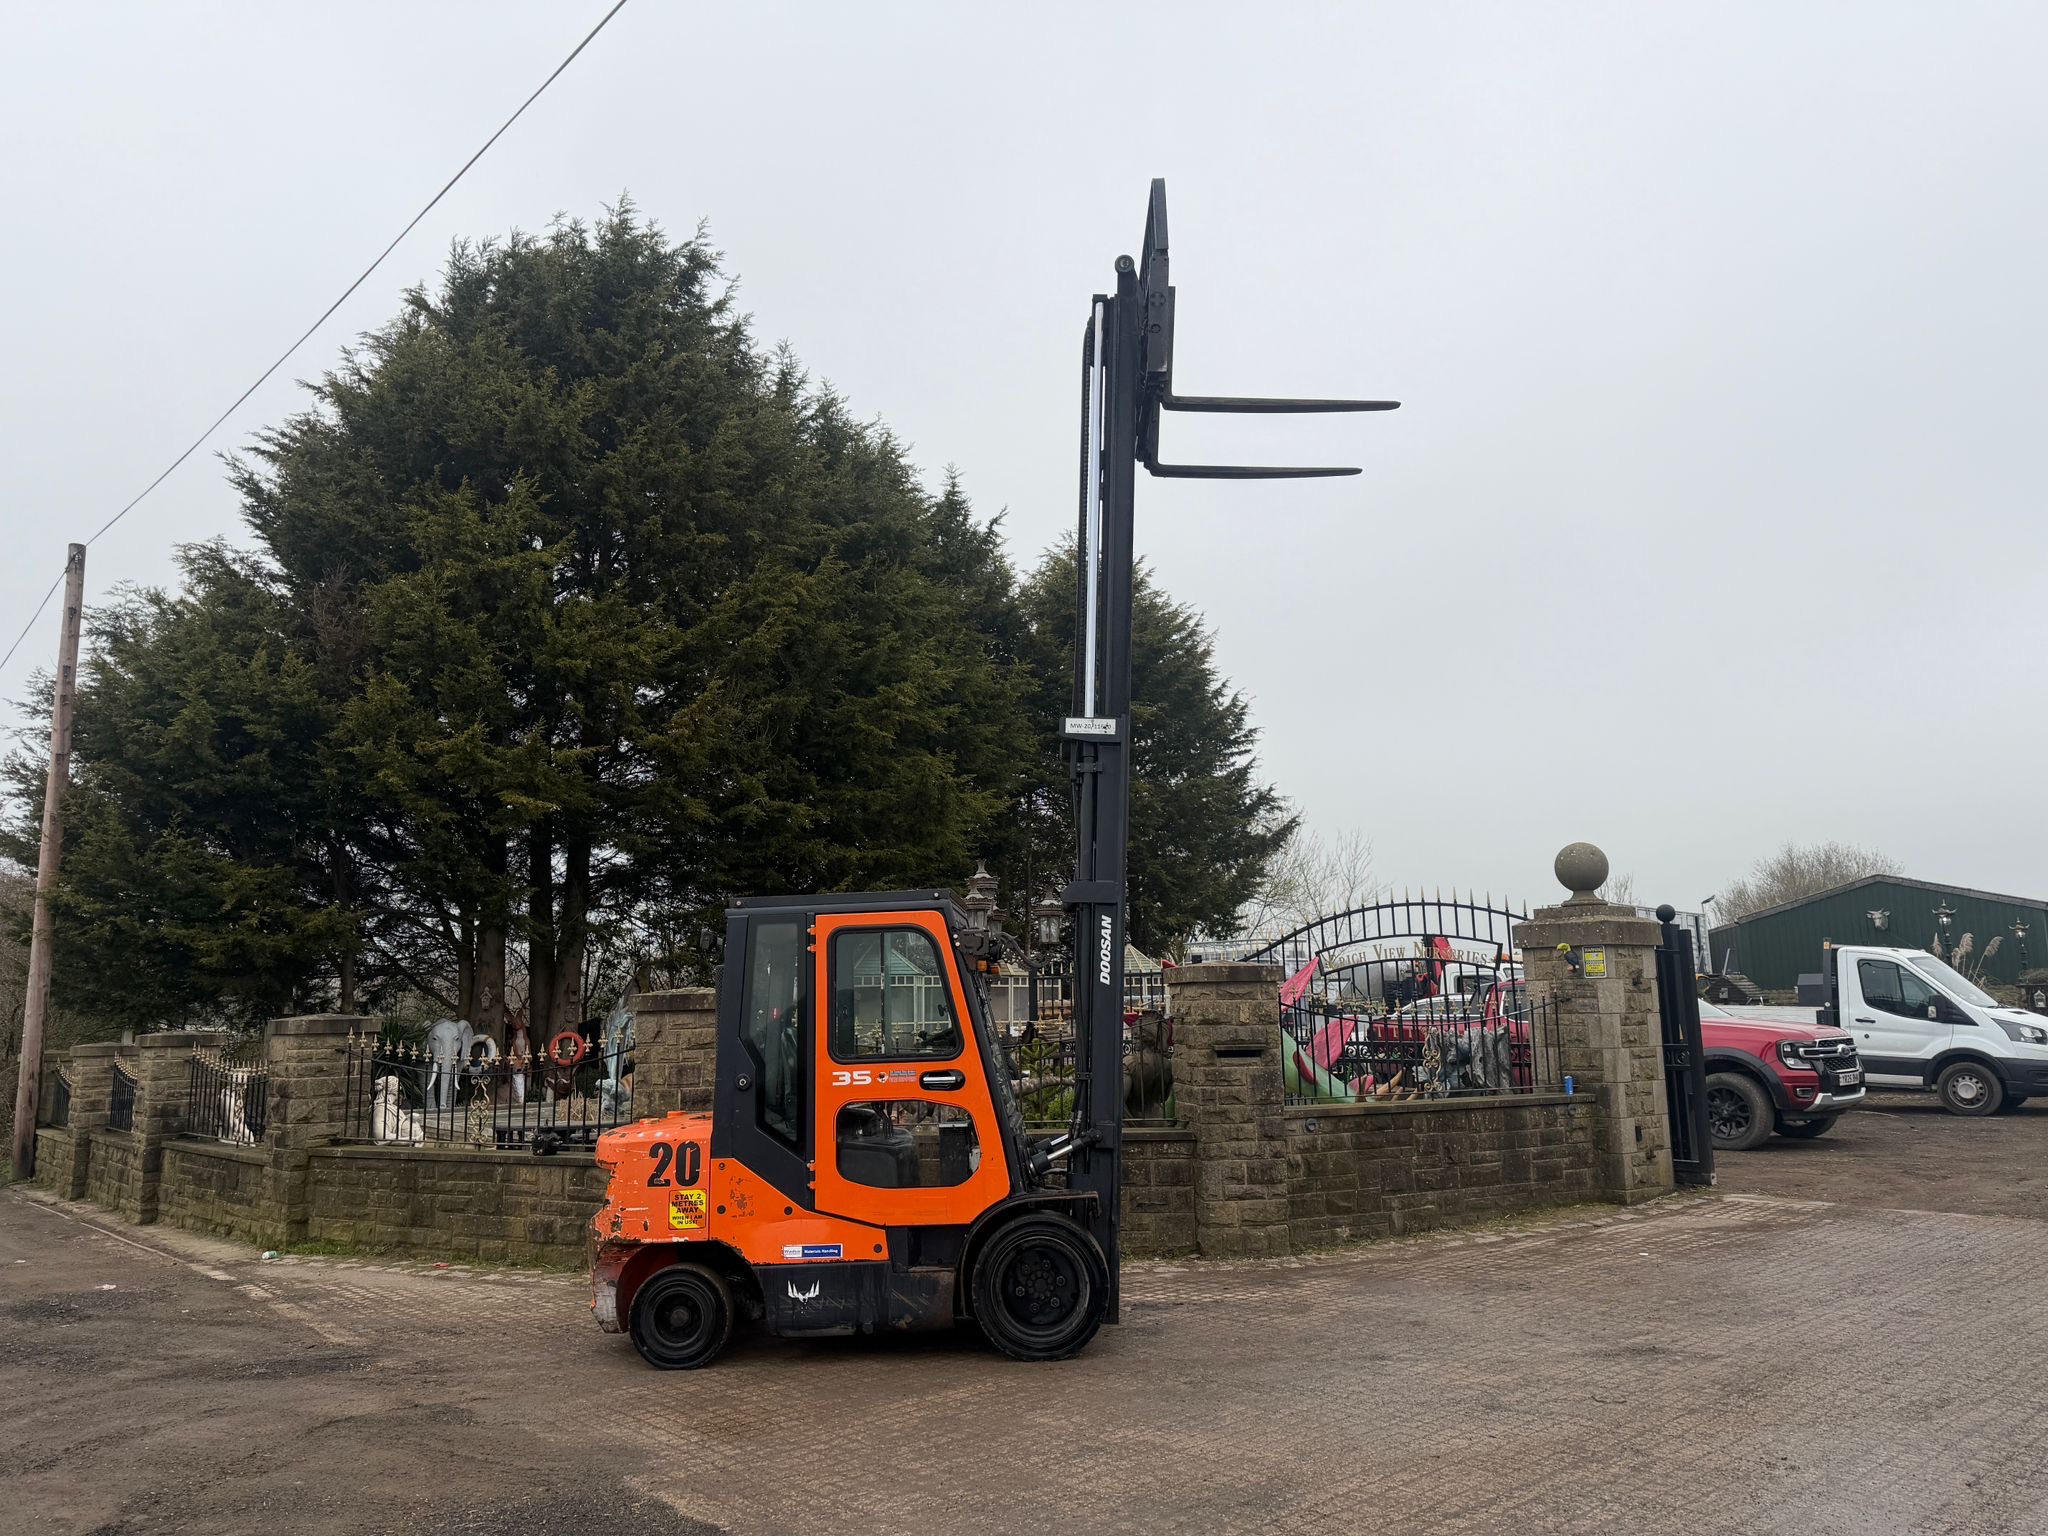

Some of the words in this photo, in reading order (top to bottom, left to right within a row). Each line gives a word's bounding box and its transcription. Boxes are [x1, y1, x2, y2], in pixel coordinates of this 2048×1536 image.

[1100, 914, 1112, 985] DOOSAN
[1372, 943, 1406, 961] VIEW
[832, 1070, 873, 1086] 35
[647, 1141, 701, 1187] 20
